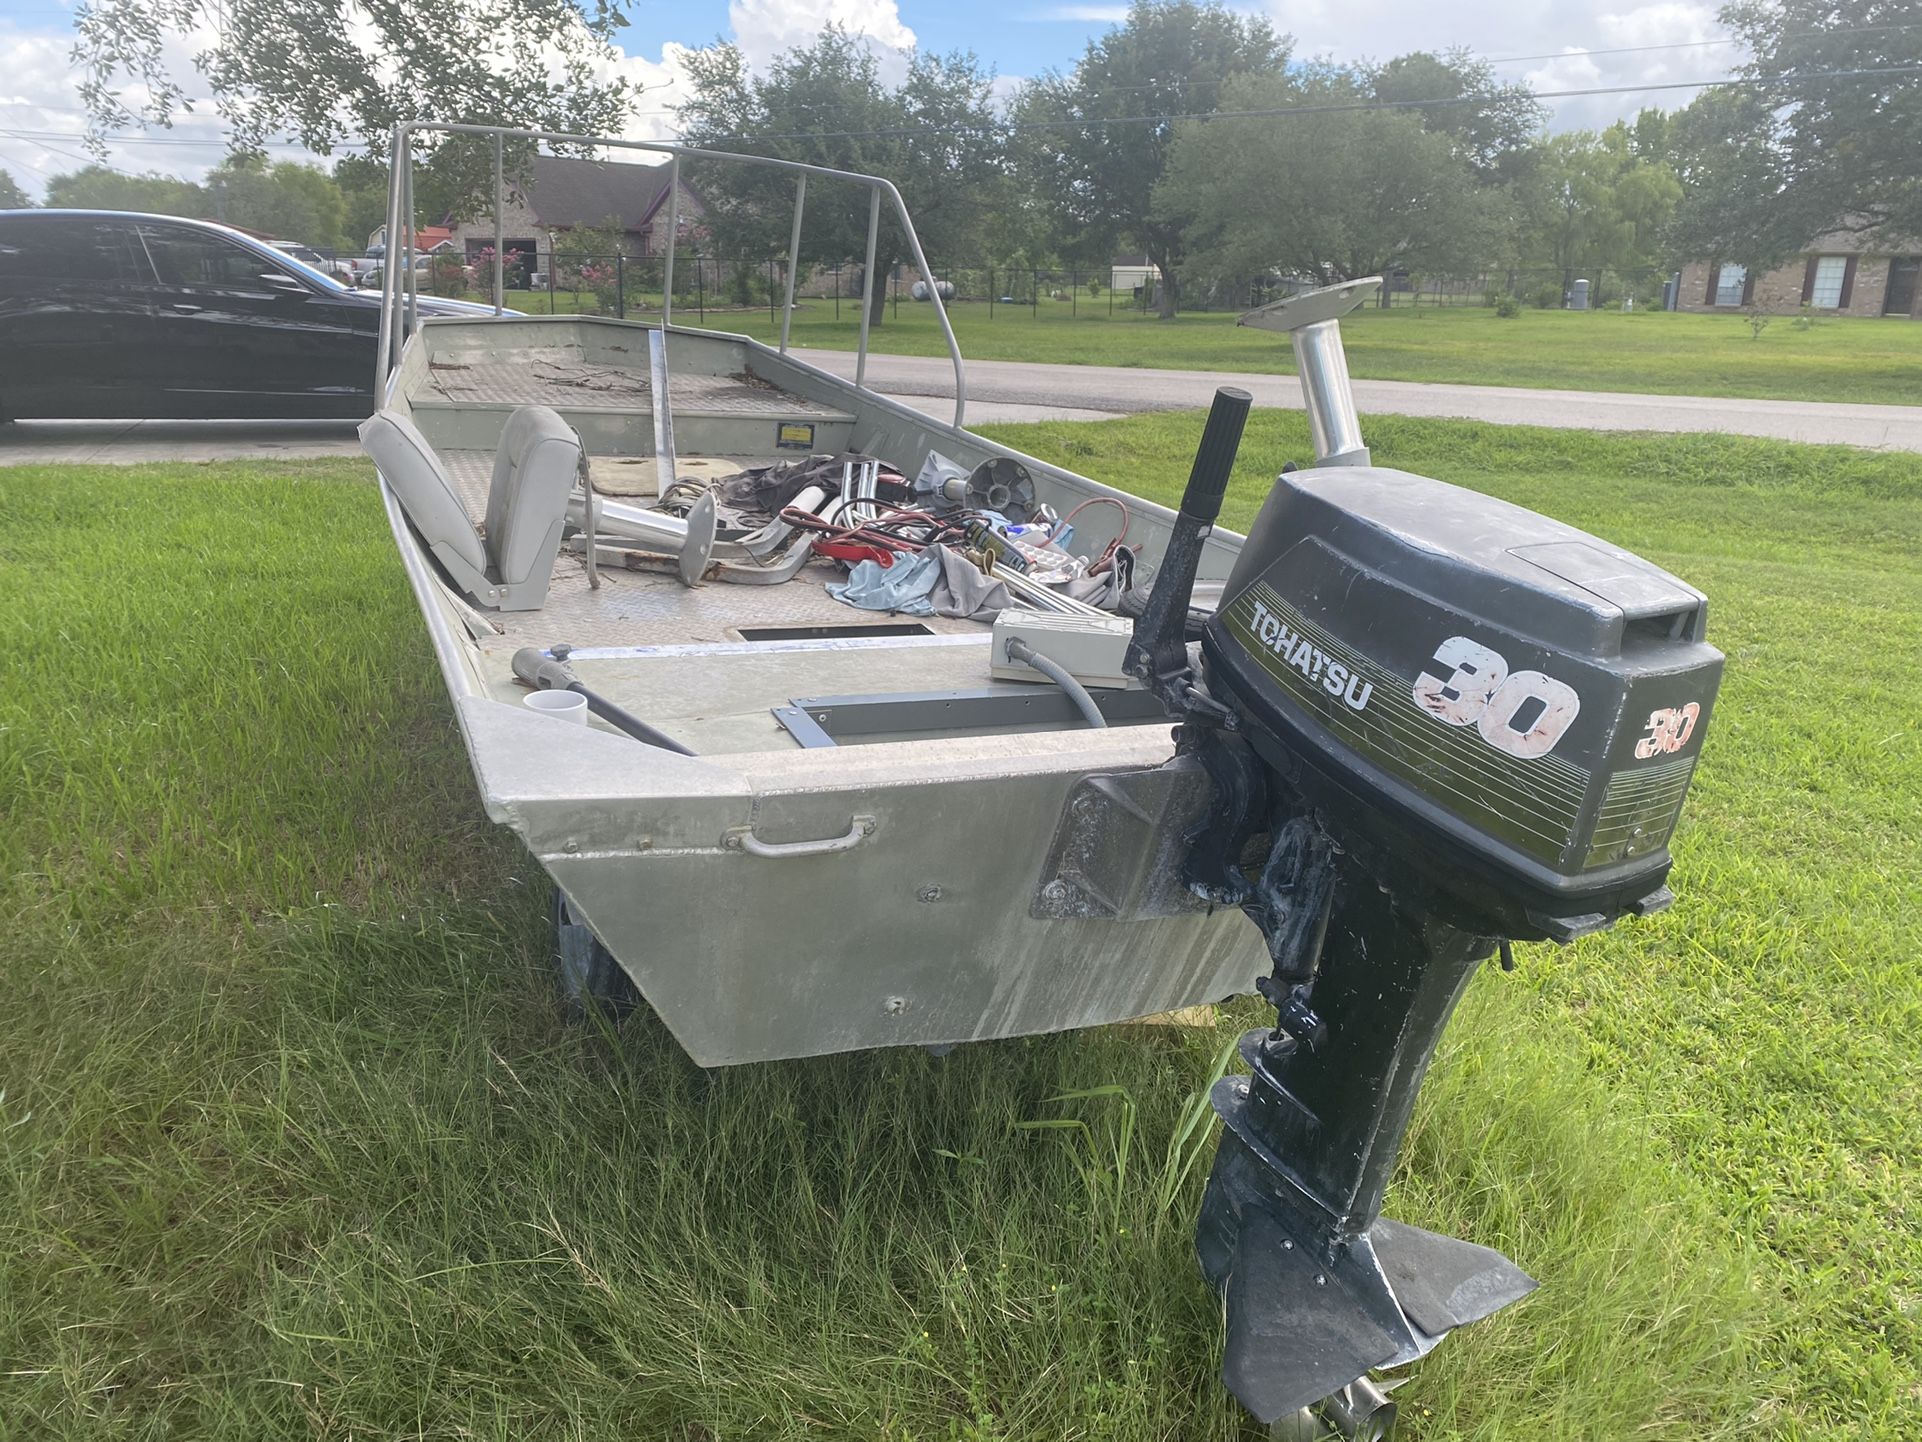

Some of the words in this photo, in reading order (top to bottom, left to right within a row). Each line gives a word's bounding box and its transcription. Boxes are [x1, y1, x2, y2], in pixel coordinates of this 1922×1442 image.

[1250, 600, 1374, 711] TOHATSU
[1413, 636, 1581, 760] 30
[1634, 701, 1701, 760] 30
